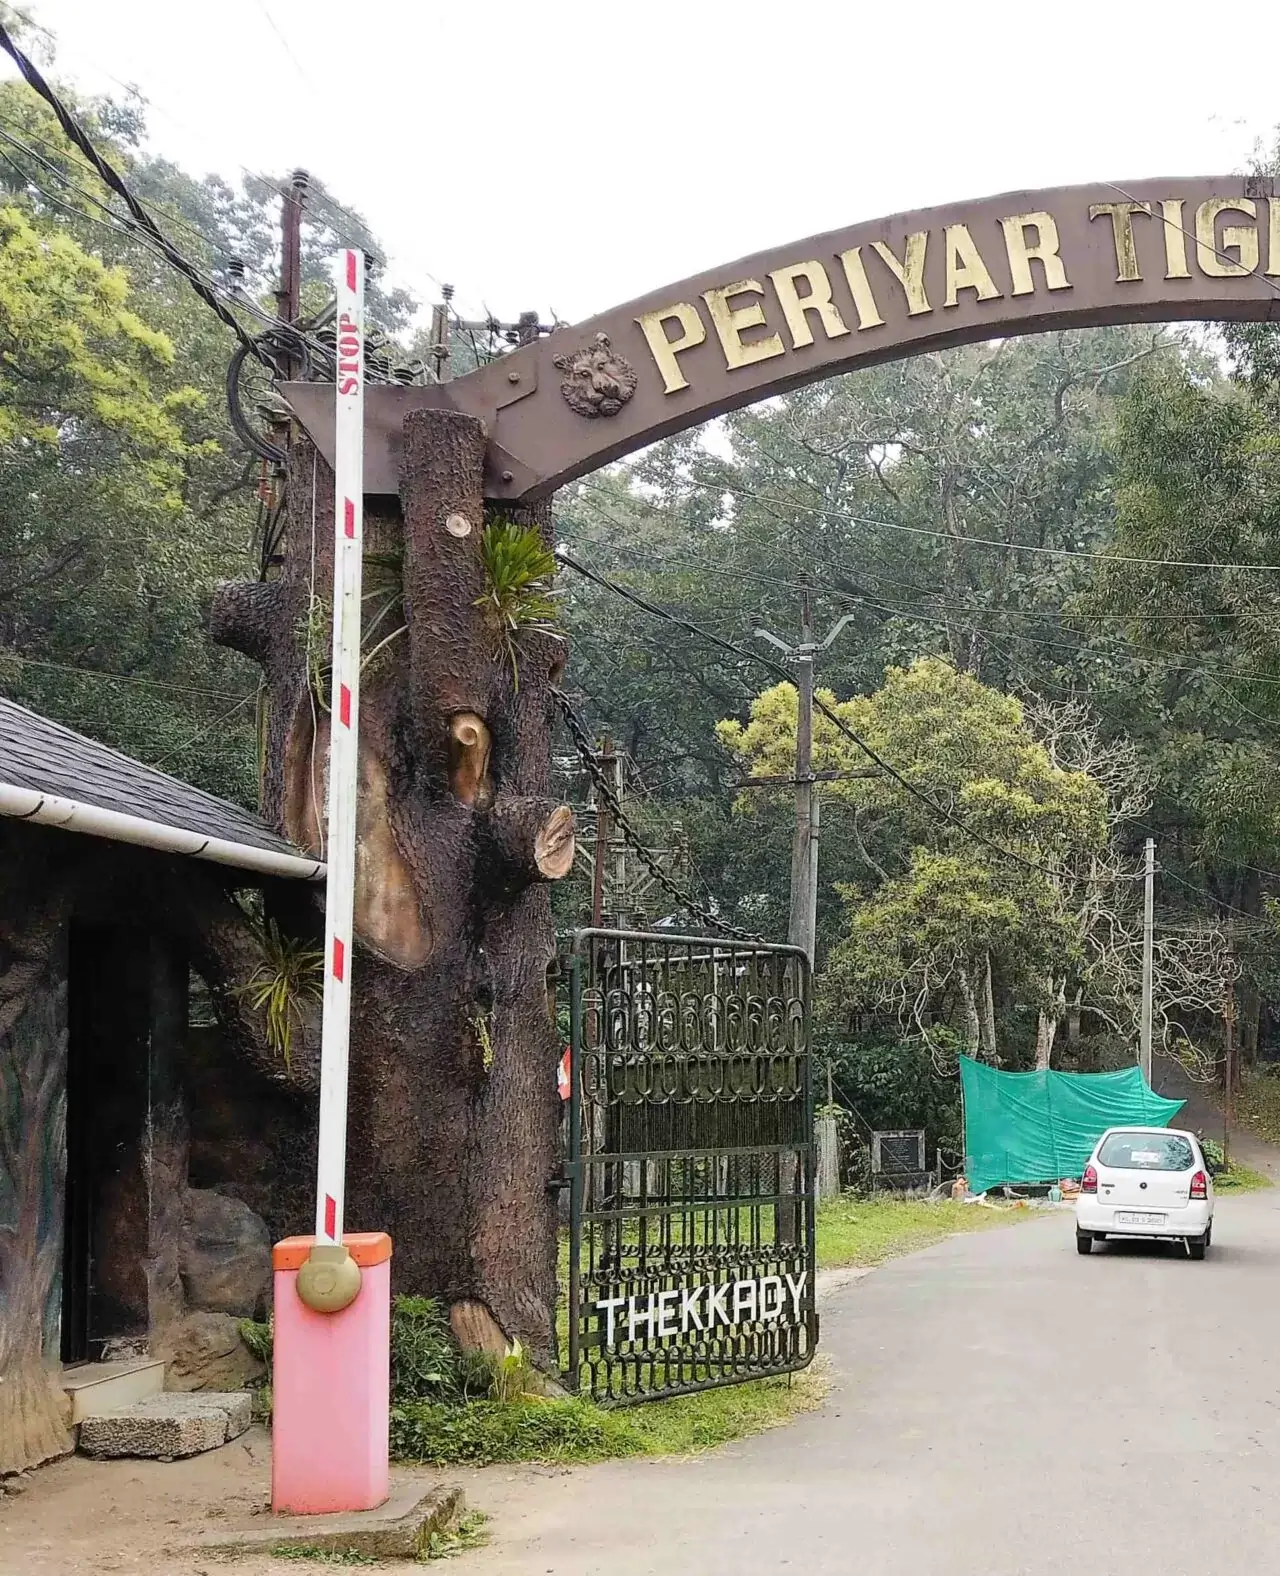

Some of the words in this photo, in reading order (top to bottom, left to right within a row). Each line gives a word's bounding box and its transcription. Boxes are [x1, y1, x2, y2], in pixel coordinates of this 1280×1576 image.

[633, 211, 1074, 396] PERIYAR
[338, 312, 361, 396] STOP
[596, 1271, 809, 1346] THEKKADY
